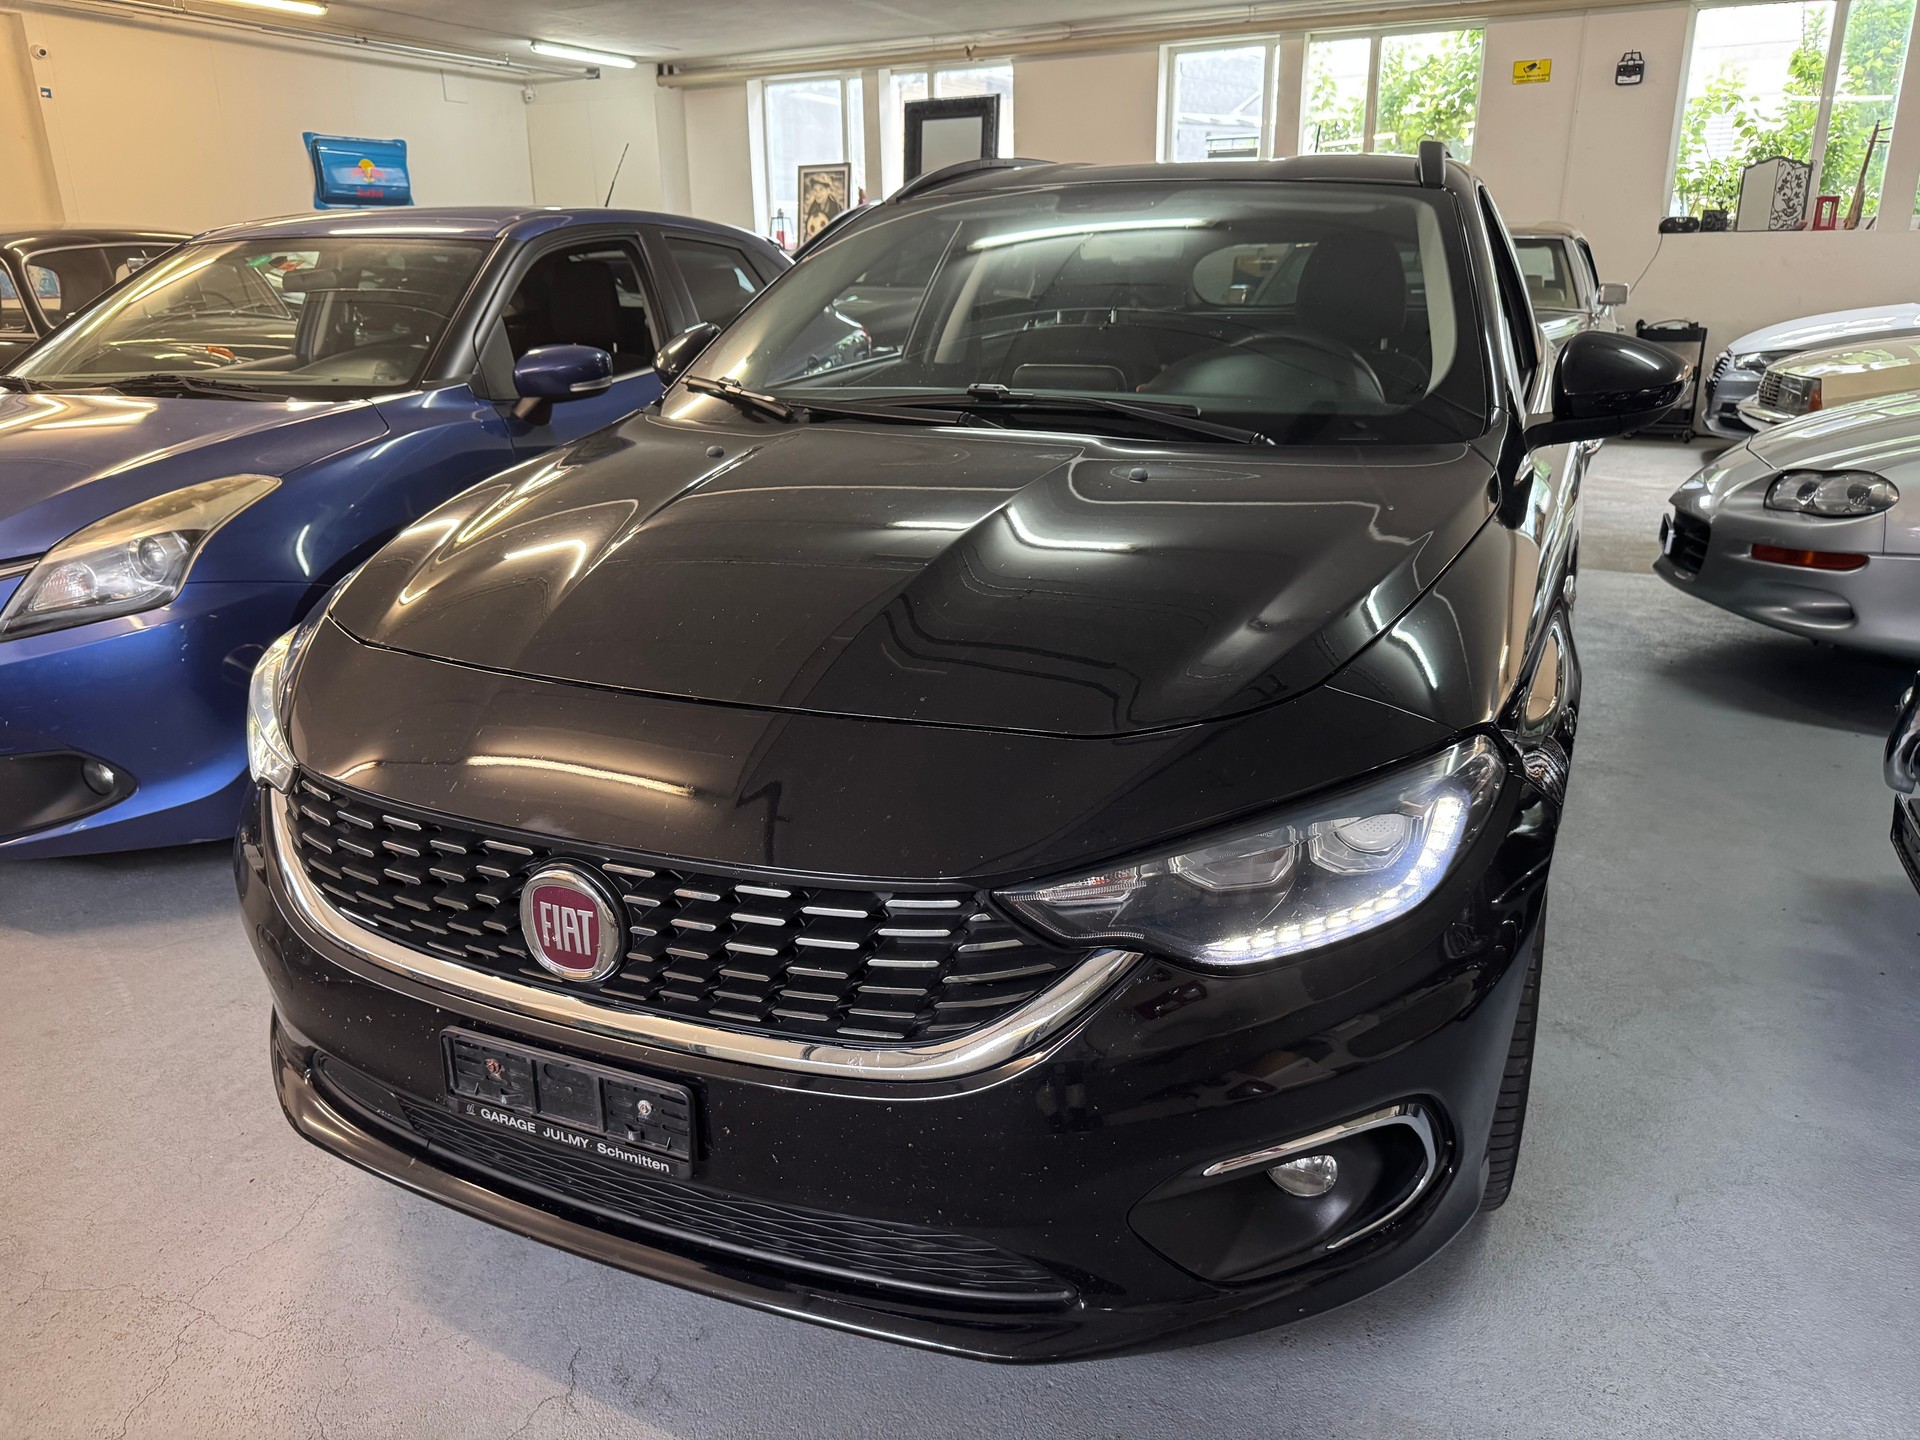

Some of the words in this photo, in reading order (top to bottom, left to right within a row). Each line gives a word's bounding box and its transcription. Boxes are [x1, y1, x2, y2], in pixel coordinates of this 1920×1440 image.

[540, 901, 593, 956] FIAT
[480, 1108, 536, 1133] GARAGE
[543, 1127, 590, 1149] JULMY
[597, 1142, 670, 1173] Schmitten
